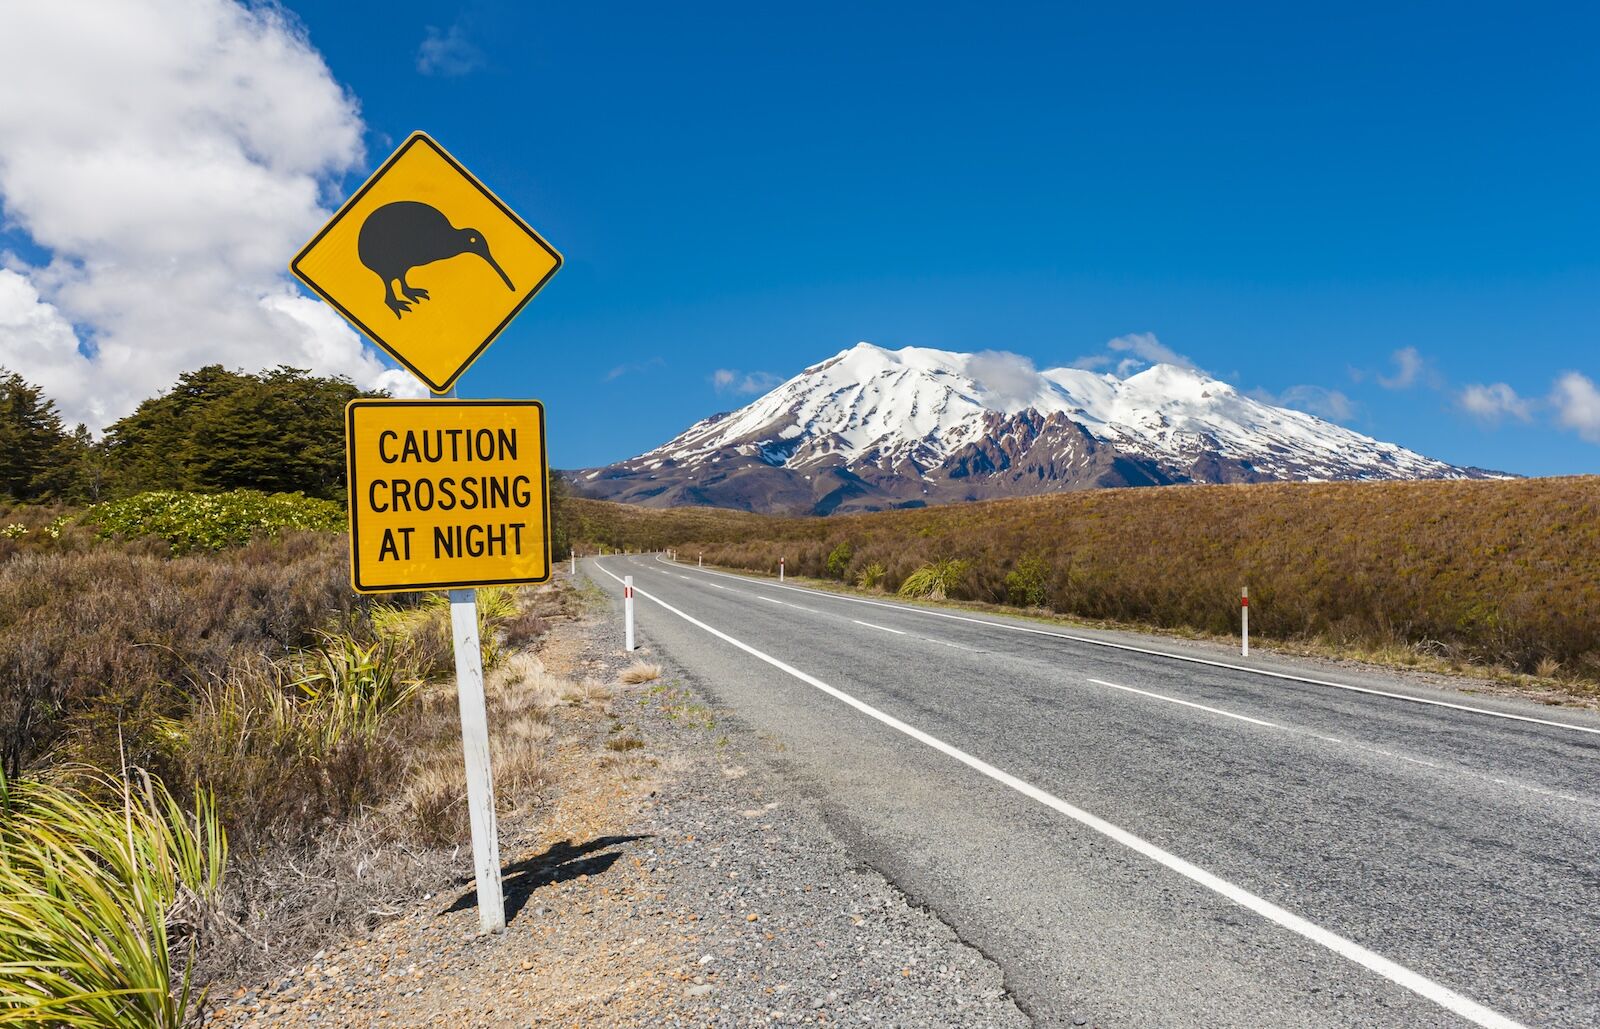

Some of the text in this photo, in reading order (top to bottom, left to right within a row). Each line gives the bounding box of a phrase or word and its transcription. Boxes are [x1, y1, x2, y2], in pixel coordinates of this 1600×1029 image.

[379, 428, 517, 464] CAUTION
[369, 475, 531, 513] CROSSING
[378, 523, 526, 562] AT NIGHT
